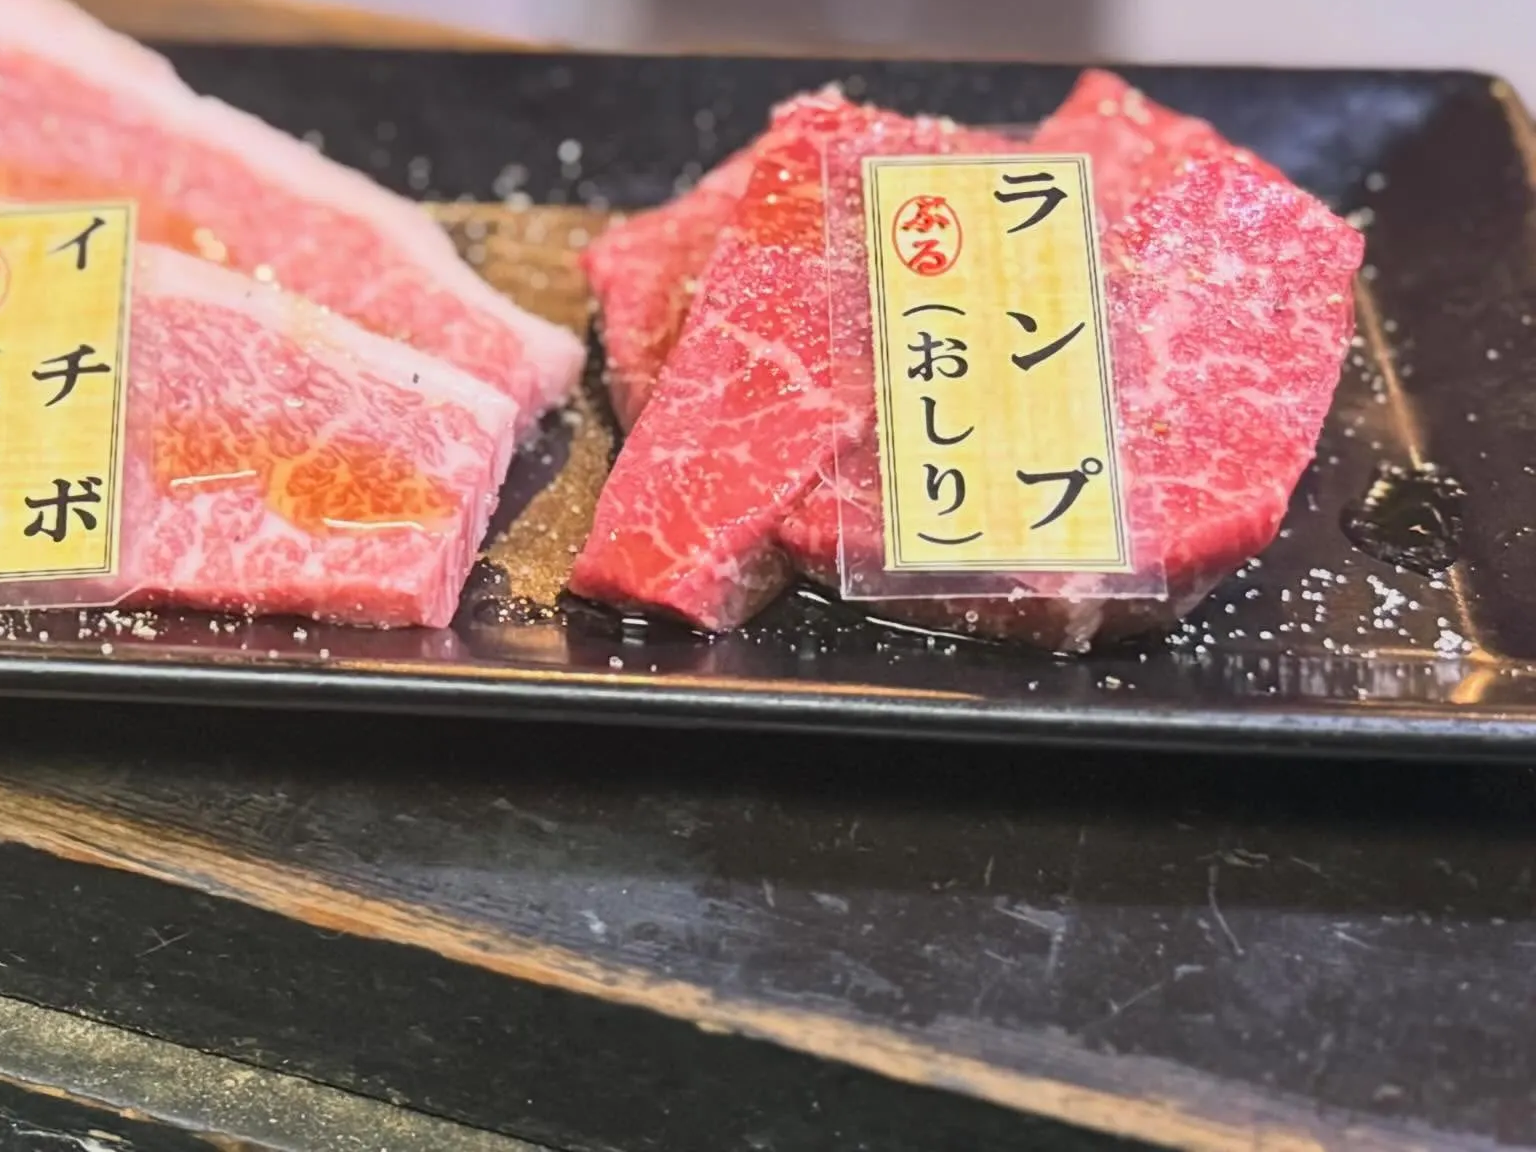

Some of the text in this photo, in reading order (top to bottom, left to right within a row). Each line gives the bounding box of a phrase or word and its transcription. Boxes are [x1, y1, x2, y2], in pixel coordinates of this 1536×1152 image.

[23, 217, 112, 543] イチボ
[994, 172, 1104, 530] ランプ
